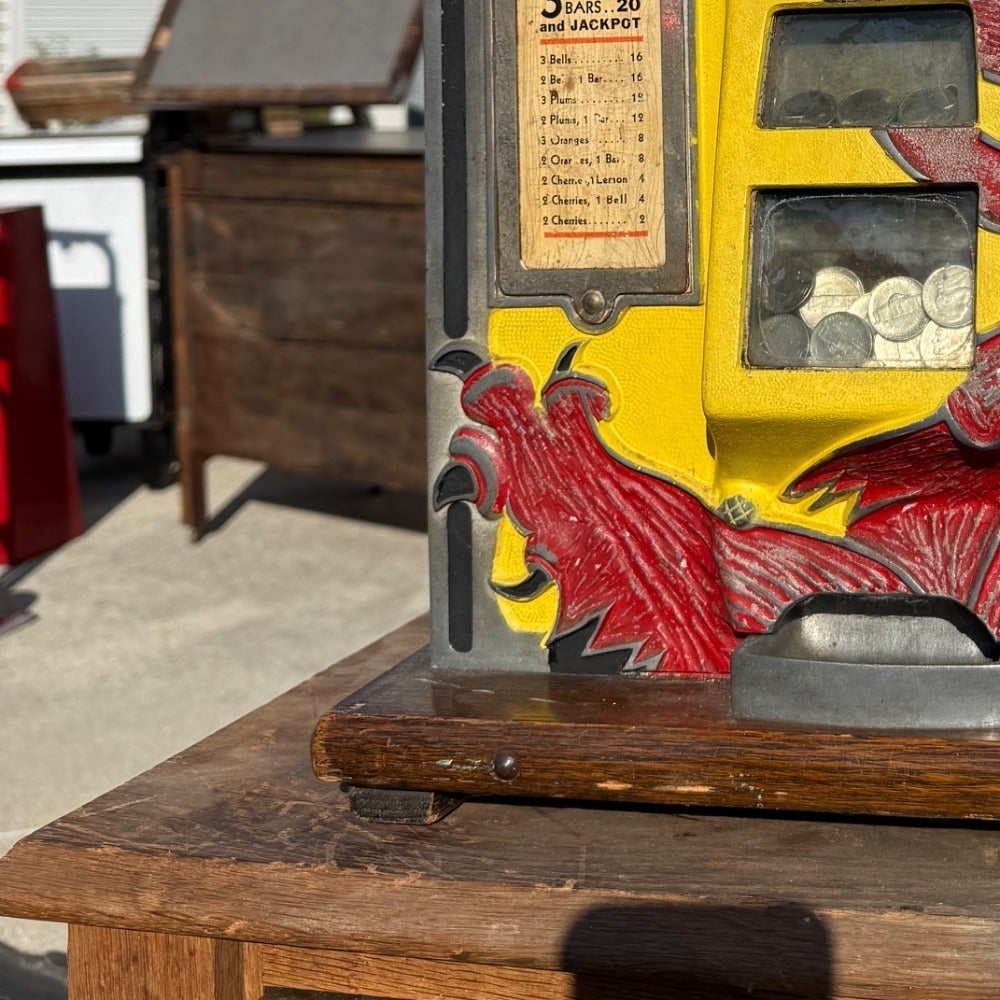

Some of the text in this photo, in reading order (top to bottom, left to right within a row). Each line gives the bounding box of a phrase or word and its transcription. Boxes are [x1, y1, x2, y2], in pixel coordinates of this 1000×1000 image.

[539, 17, 642, 33] and JACKPOT
[541, 52, 643, 65] 3 Bells 16
[541, 76, 547, 85] 2
[630, 73, 643, 82] 16
[541, 96, 547, 105] 3
[541, 116, 547, 125] 2
[631, 113, 644, 122] 12
[541, 136, 547, 145] 3
[638, 134, 644, 142] 8
[542, 156, 547, 165] 2
[639, 154, 644, 163] 8
[542, 176, 548, 185] 2
[639, 173, 644, 183] 4
[543, 196, 548, 205] 2
[606, 193, 628, 204] Bell
[639, 194, 644, 204] 4
[543, 215, 646, 226] 2 Cherries 2
